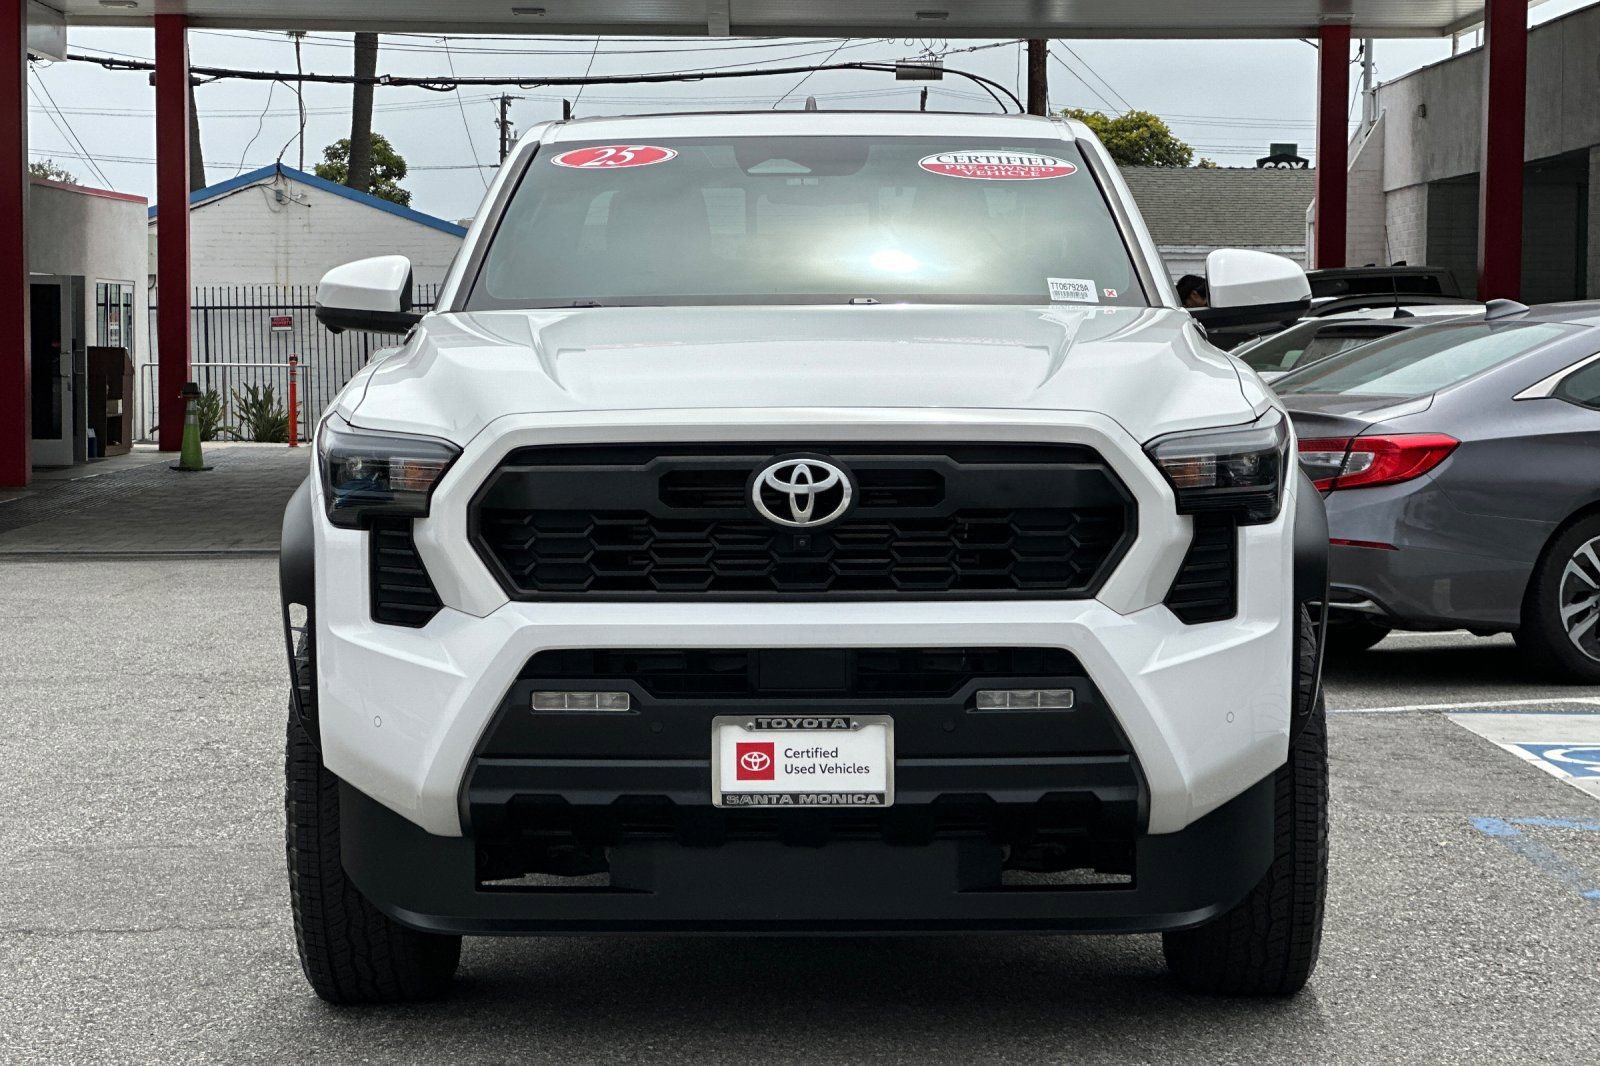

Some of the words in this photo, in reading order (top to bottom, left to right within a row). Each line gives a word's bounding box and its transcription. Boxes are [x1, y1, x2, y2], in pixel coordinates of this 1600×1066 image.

[578, 146, 646, 167] 25
[936, 155, 1057, 166] CERTIFIED
[945, 164, 1055, 172] PRE-OWNED
[757, 718, 848, 728] TOYOTA
[784, 747, 839, 758] Certified
[784, 763, 816, 774] Used
[819, 763, 870, 774] Vehicles
[726, 794, 794, 805] SANTA
[799, 794, 881, 805] MONICA
